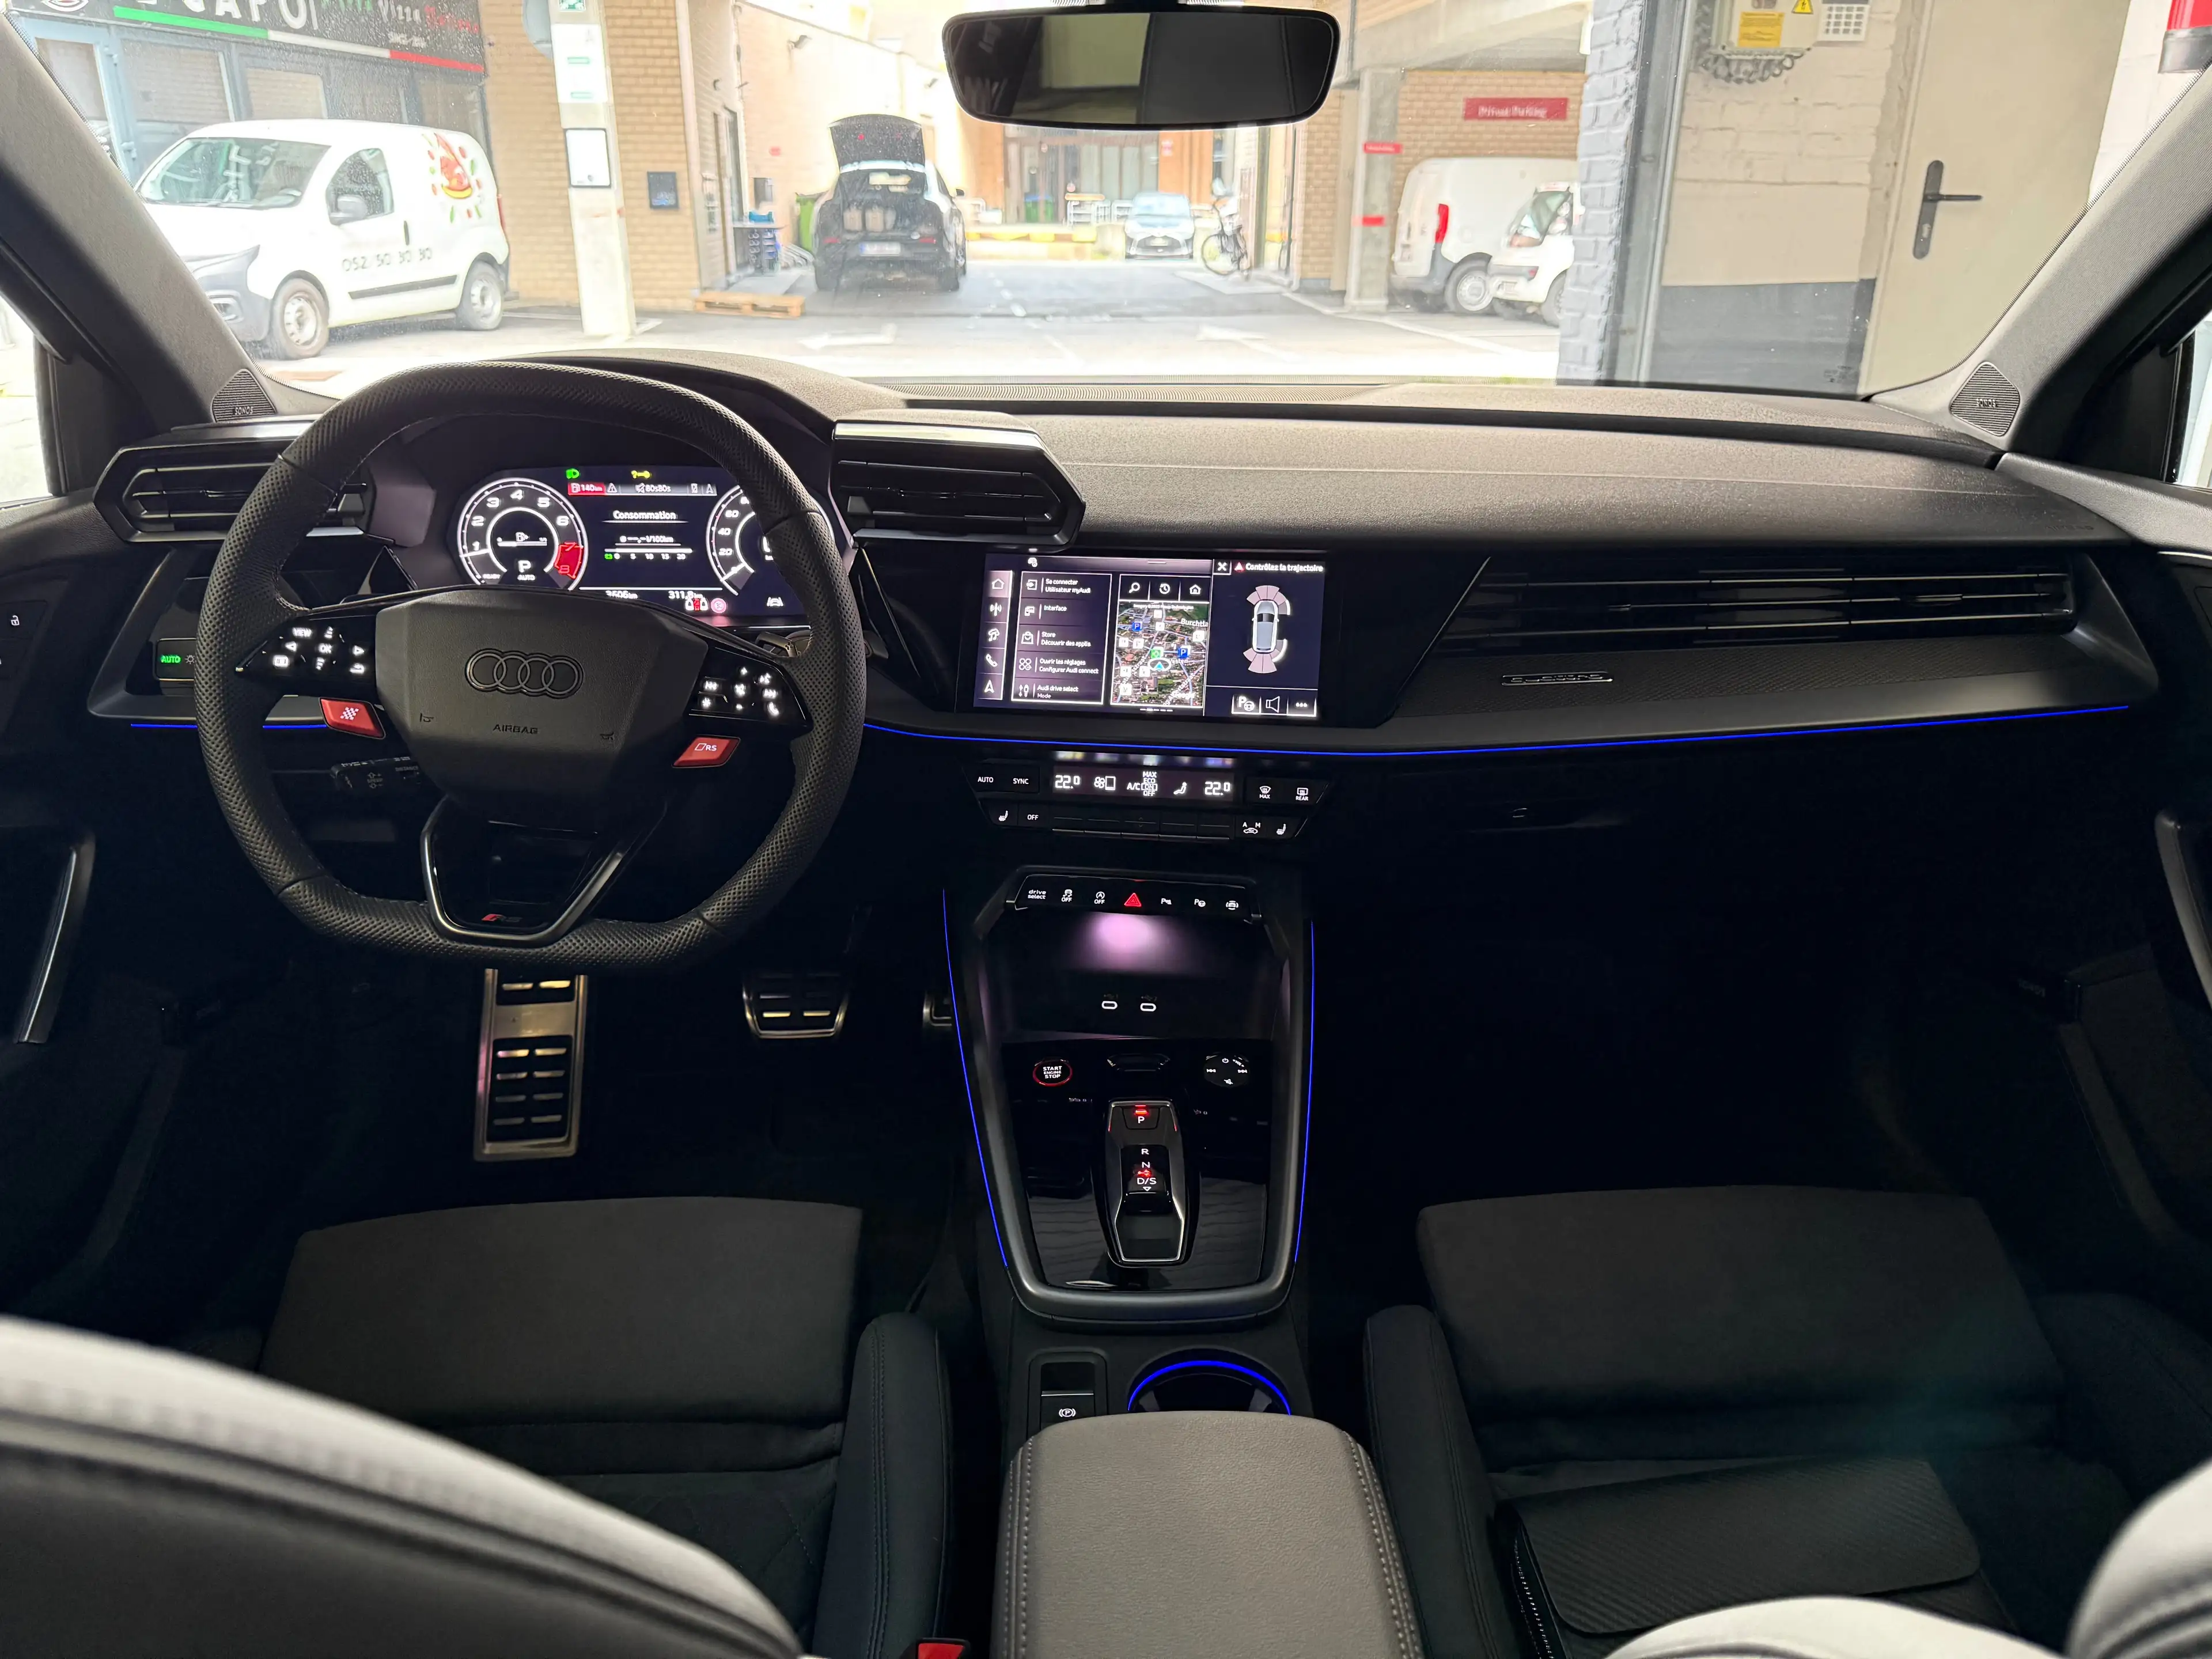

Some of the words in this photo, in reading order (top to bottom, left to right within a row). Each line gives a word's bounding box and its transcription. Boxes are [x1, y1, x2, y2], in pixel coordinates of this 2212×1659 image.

[234, 406, 253, 415] SONOS
[510, 489, 523, 500] 4
[486, 497, 500, 508] 3
[537, 497, 551, 508] 5
[613, 510, 677, 520] Consommation
[471, 516, 485, 527] 2
[556, 516, 570, 527] 6
[718, 528, 731, 536] 40
[472, 541, 480, 551] 1
[564, 542, 577, 551] 7
[719, 548, 733, 556] 20
[518, 560, 532, 573] P
[559, 565, 570, 574] 8
[1245, 563, 1279, 571] Contrôlez
[1279, 563, 1287, 571] la
[1287, 564, 1324, 573] trajectoire
[292, 627, 312, 638] VIEW
[318, 643, 332, 654] OK
[161, 654, 181, 664] AUTO
[493, 724, 538, 734] AIRBAG
[1013, 777, 1029, 785] SYNC
[1127, 782, 1141, 791] A/C
